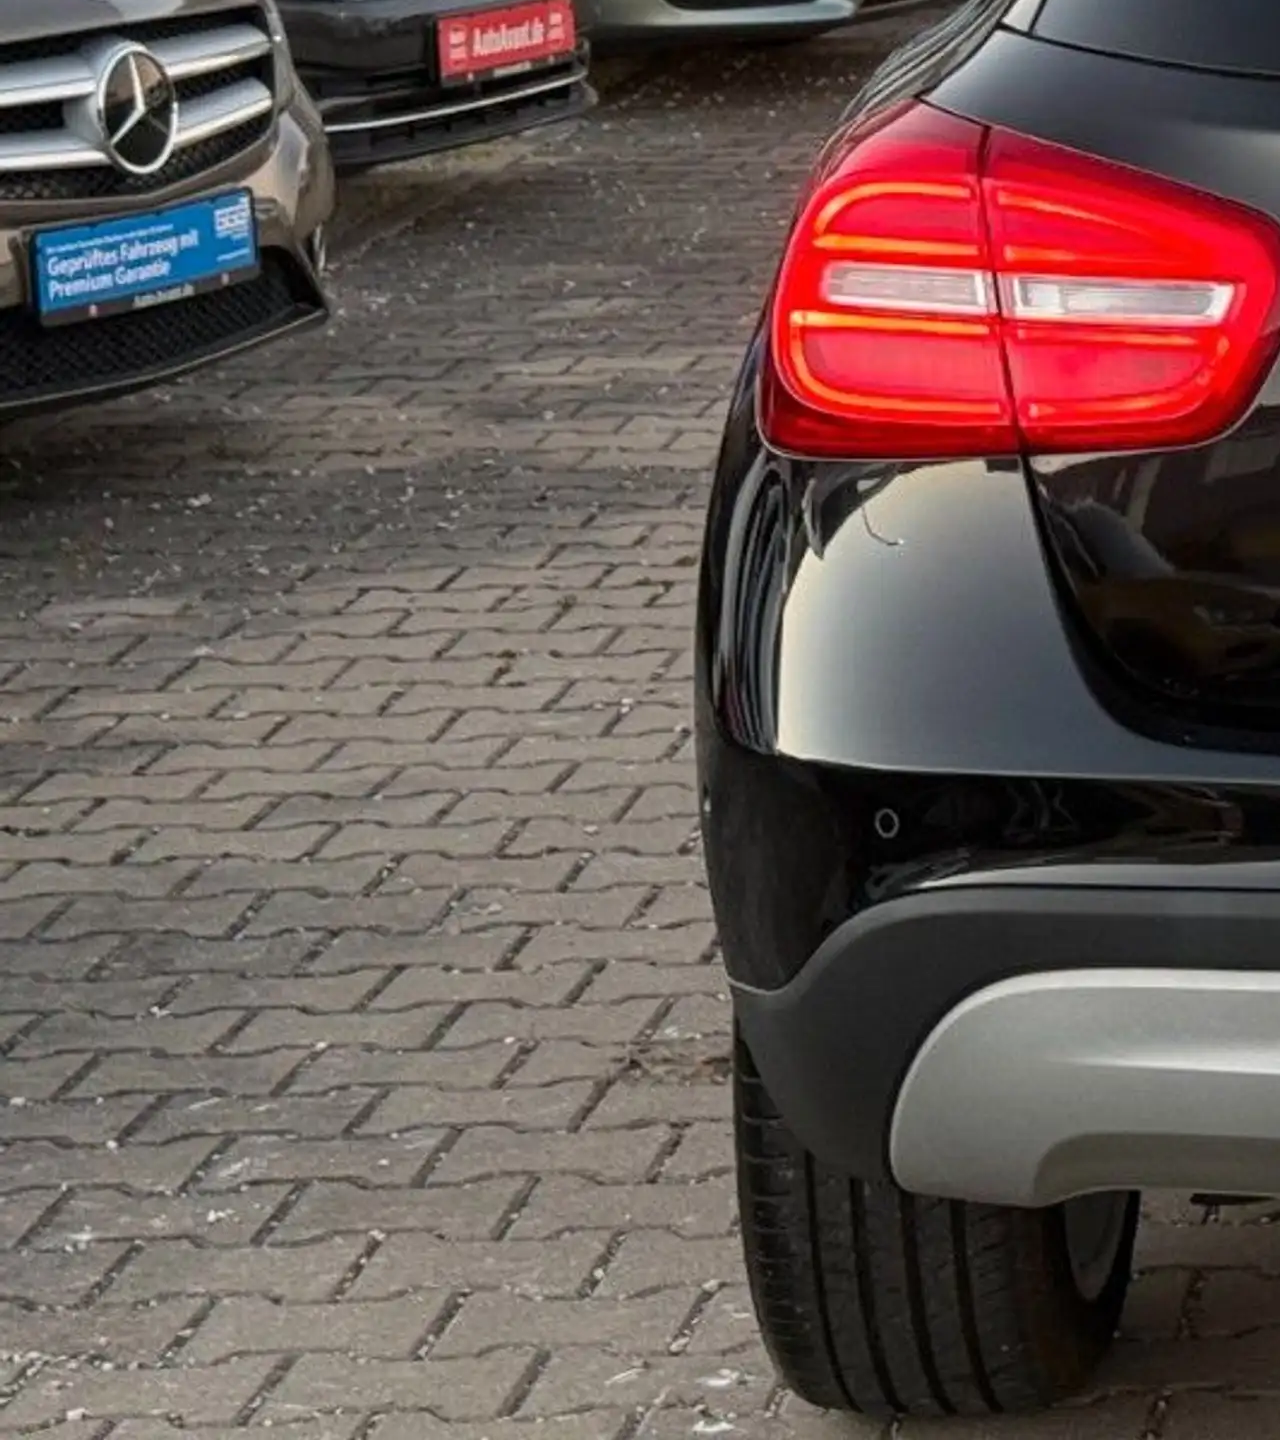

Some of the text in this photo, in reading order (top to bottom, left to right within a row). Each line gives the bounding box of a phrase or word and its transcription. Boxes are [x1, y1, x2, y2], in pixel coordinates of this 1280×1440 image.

[46, 247, 119, 277] Geprüftes
[120, 236, 178, 261] Fahrzeug
[179, 228, 200, 250] mit
[49, 258, 172, 302] Premium Garantie
